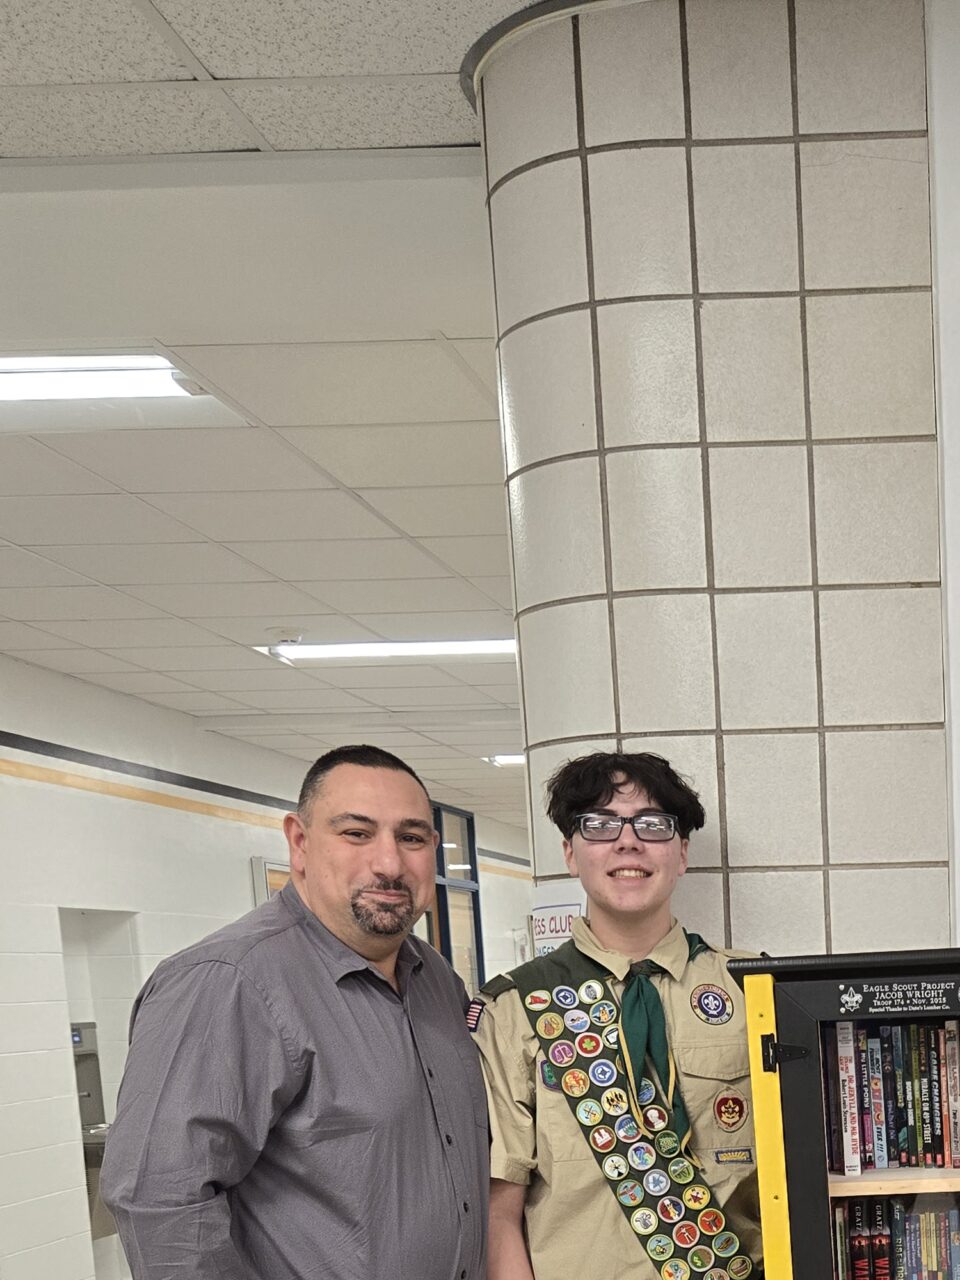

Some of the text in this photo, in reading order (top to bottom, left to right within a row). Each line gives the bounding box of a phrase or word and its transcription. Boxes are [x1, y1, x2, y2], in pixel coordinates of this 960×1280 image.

[863, 984, 889, 992] EAGLE
[921, 982, 955, 990] PROJECT
[875, 990, 943, 1000] JACOB WRIGHT
[930, 1051, 942, 1136] GAME CHANGERS
[923, 1124, 931, 1143] STREET
